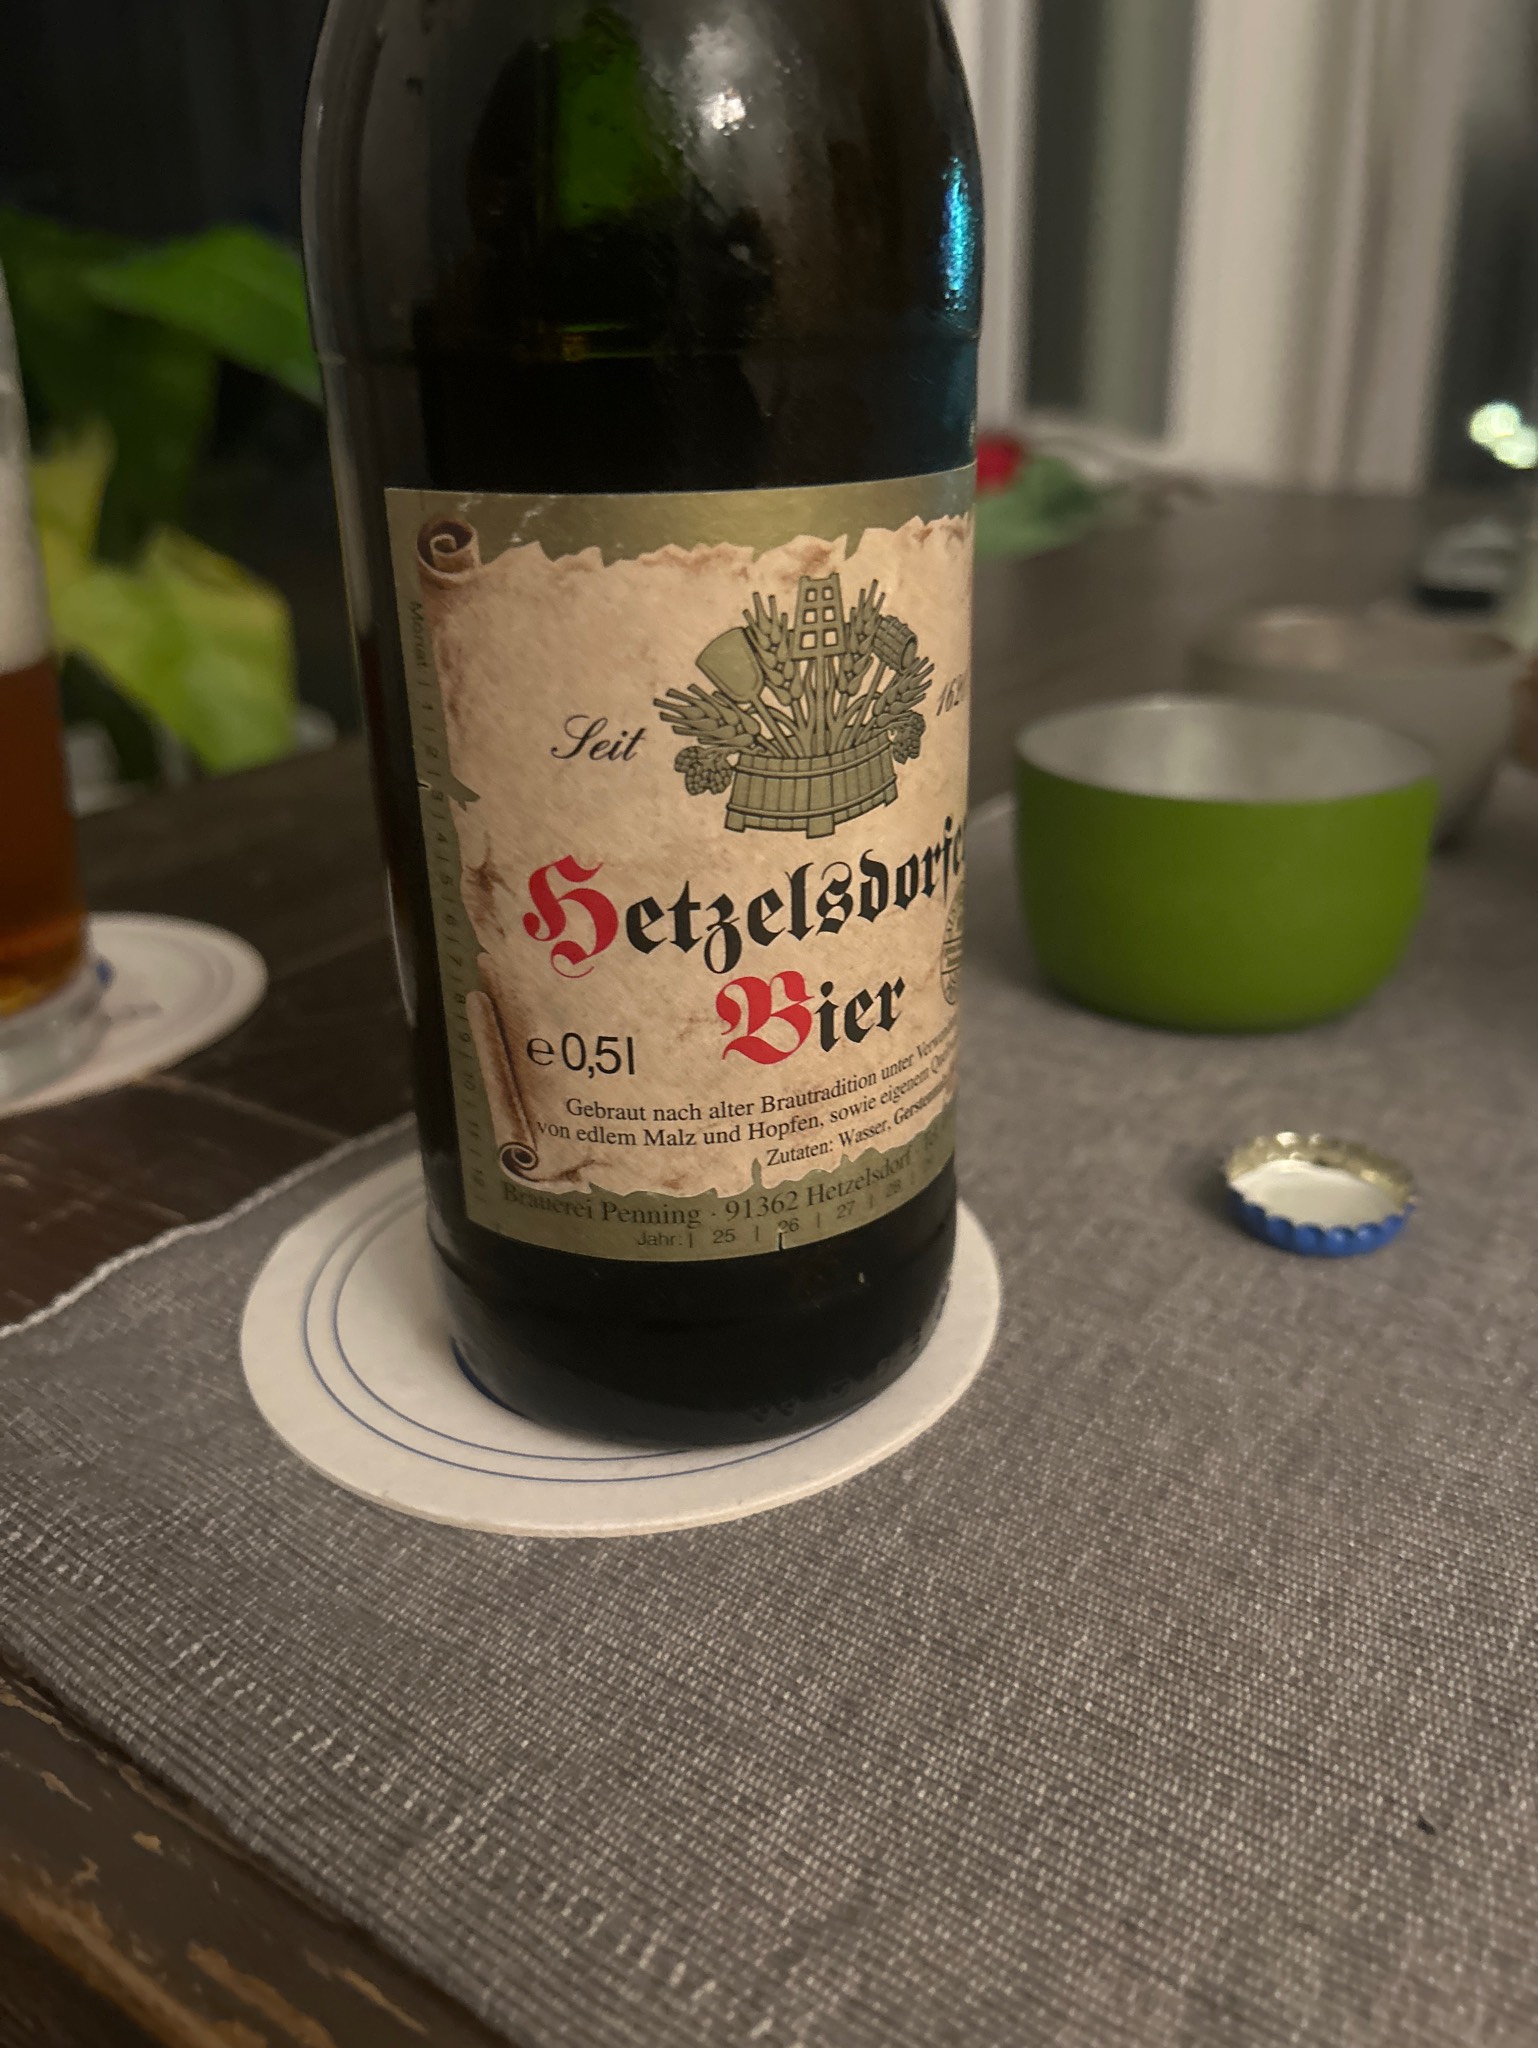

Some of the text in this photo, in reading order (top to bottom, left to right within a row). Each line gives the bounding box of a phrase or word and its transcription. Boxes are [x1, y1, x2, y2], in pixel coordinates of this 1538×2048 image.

[550, 714, 647, 761] Seit
[522, 814, 967, 979] Hetzelsdorfe
[714, 970, 907, 1065] Bier
[537, 1120, 571, 1140] von
[576, 1127, 637, 1146] edlem
[643, 1127, 697, 1147] Malz
[703, 1125, 742, 1145] und
[748, 1114, 825, 1144] Hopfen,
[829, 1095, 876, 1124] sowie
[879, 1067, 929, 1106] eigenem
[565, 1097, 646, 1122] Gebraut
[652, 1103, 701, 1122] nach
[708, 1101, 755, 1119] alter
[761, 1073, 877, 1114] Brautradition
[881, 1053, 914, 1080] unter
[503, 1181, 593, 1219] Brauerei
[602, 1200, 702, 1229] Penning
[725, 1190, 799, 1222] 91362
[806, 1144, 915, 1207] Hetzelsdorf
[766, 1139, 834, 1167] Zutaten:
[637, 1231, 683, 1247] Jahr:
[712, 1227, 737, 1245] 25
[779, 1217, 801, 1235] 26
[836, 1200, 856, 1220] 27
